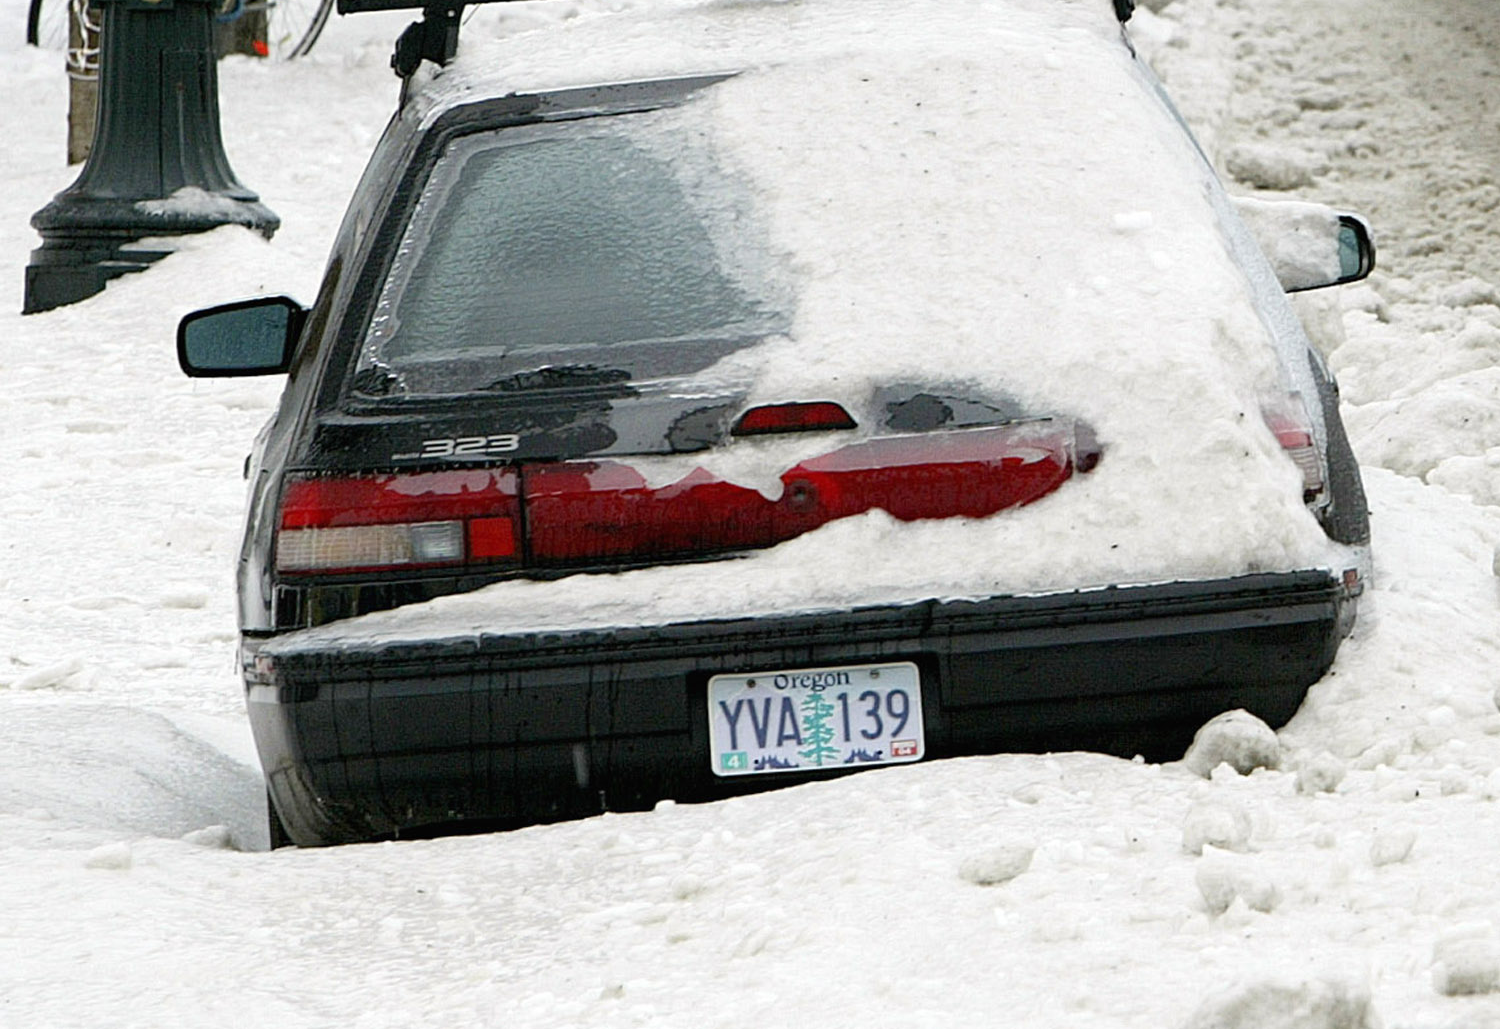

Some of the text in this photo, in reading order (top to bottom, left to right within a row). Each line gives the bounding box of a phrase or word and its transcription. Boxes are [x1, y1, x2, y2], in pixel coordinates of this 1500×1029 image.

[421, 433, 520, 459] 323
[773, 671, 851, 693] Oregon
[719, 689, 911, 750] YVA 139
